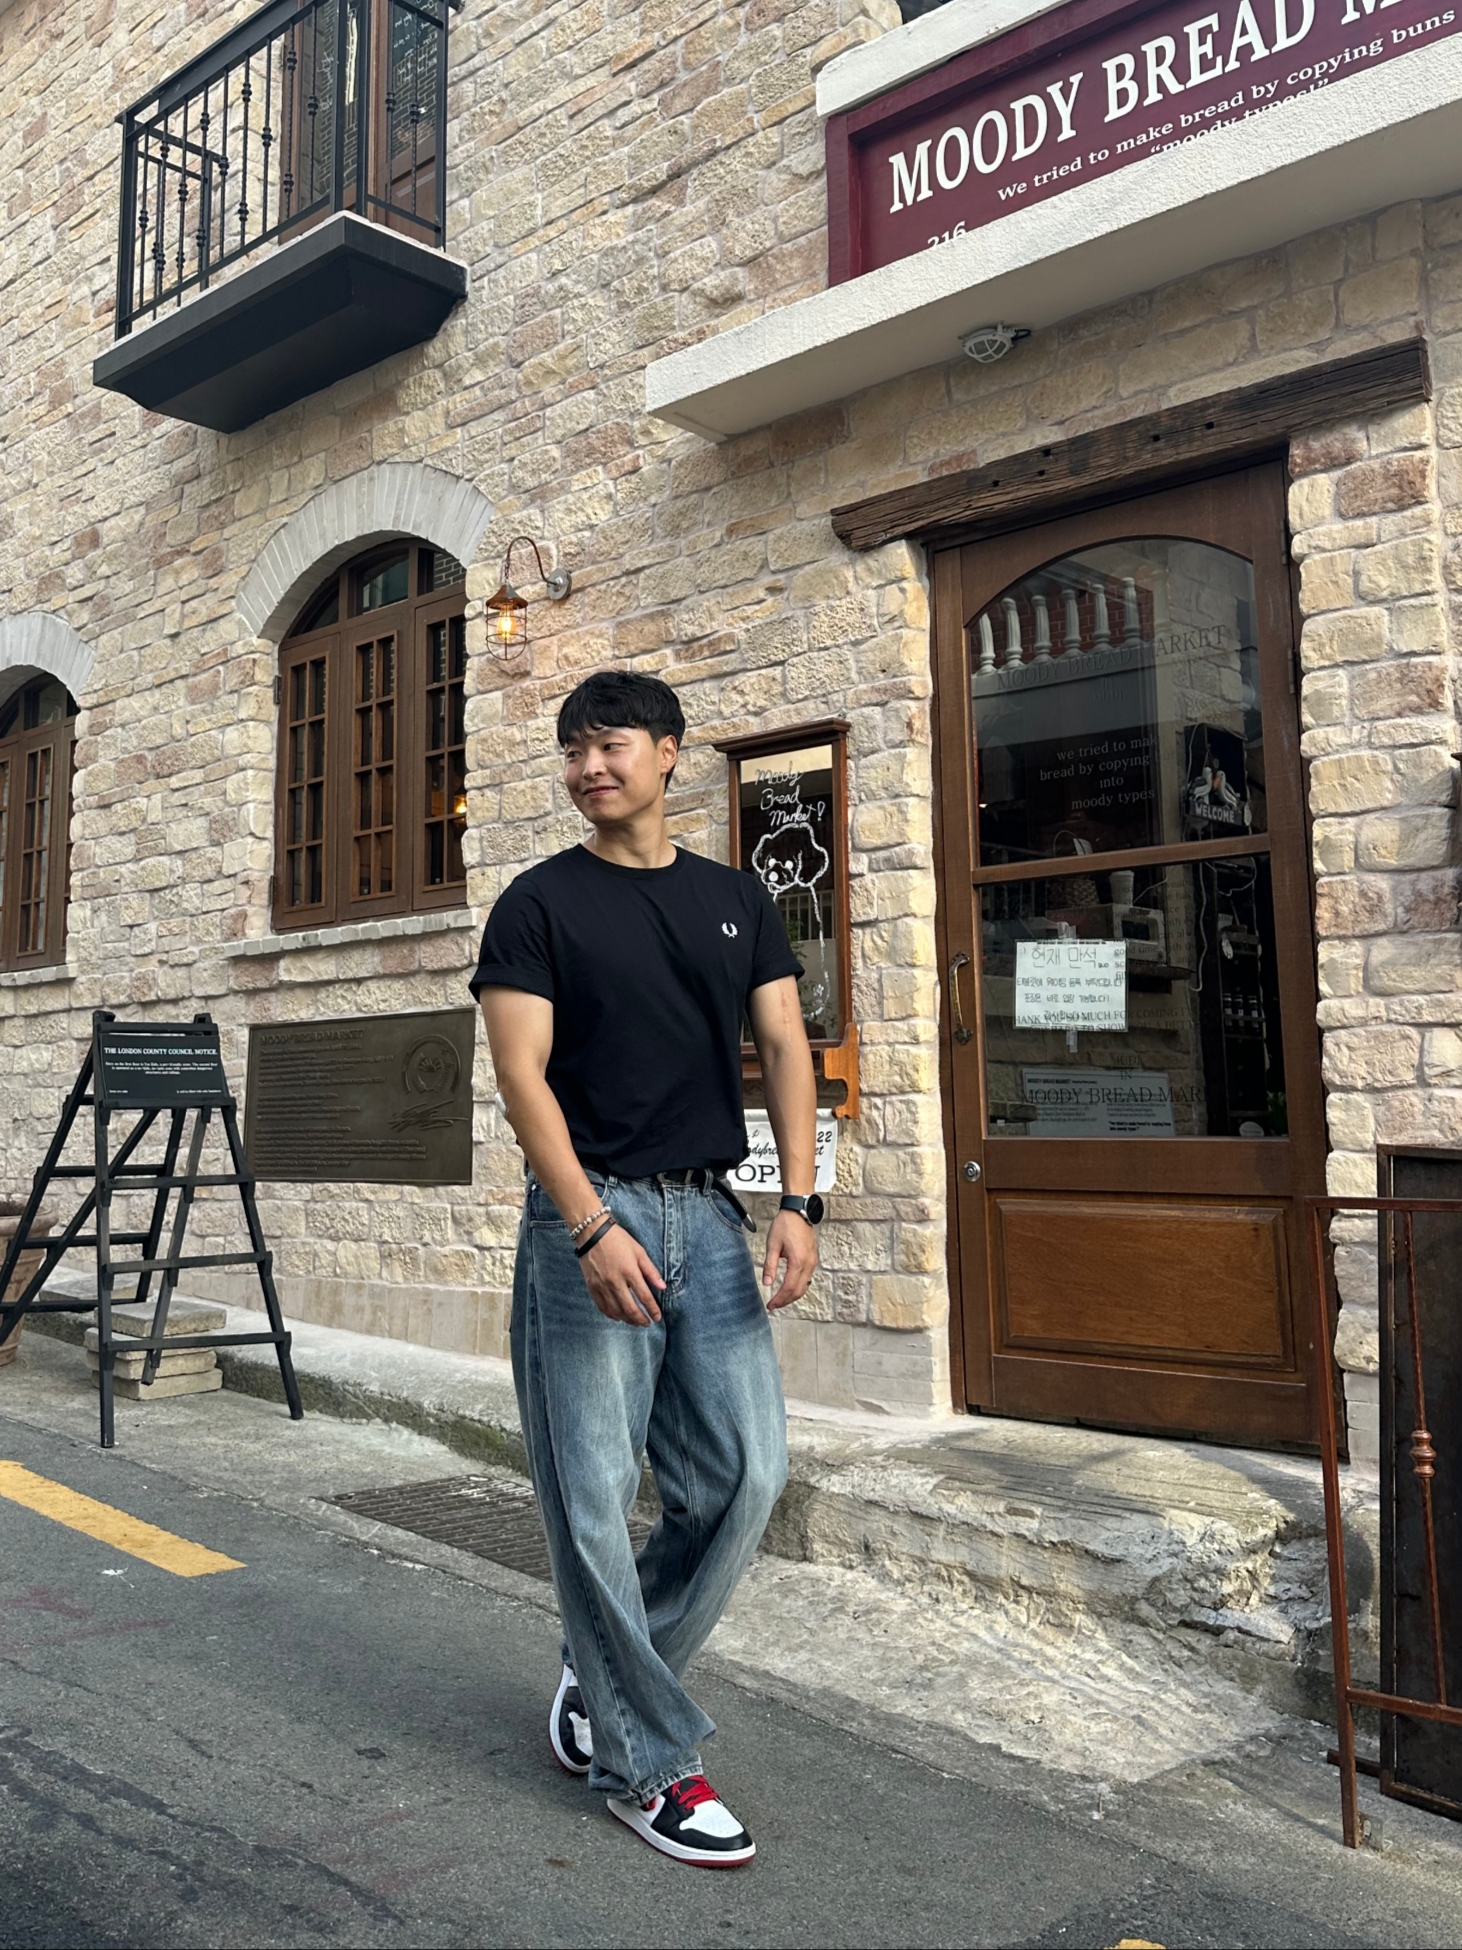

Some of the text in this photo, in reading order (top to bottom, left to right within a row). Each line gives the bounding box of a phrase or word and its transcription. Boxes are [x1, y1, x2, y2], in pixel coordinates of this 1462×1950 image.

[888, 0, 1315, 213] MOODY BREAD
[997, 182, 1028, 201] We
[1033, 157, 1083, 186] tried
[1088, 148, 1110, 165] to
[1116, 121, 1174, 154] make
[1180, 91, 1245, 128] bread
[1251, 79, 1280, 100] by
[1286, 37, 1384, 86] copying
[1391, 9, 1456, 45] buns
[997, 661, 1060, 690] MOODY
[1067, 647, 1133, 675] BREAD
[1056, 734, 1159, 761] we tried to mak
[1039, 765, 1075, 781] bread
[1079, 763, 1094, 775] by
[1098, 754, 1150, 772] copying
[1098, 776, 1125, 789] into
[760, 785, 801, 811] Bread
[1070, 788, 1156, 810] moody types
[1195, 802, 1235, 823] WELCOME
[1031, 946, 1061, 968] 현재
[1068, 946, 1097, 969] 만석
[1012, 1014, 1041, 1025] HANK
[1136, 1007, 1178, 1019] COMING
[117, 1047, 142, 1055] LONDON
[142, 1047, 167, 1055] COUNTY
[1021, 1086, 1206, 1104] MOODY BREAD MAR
